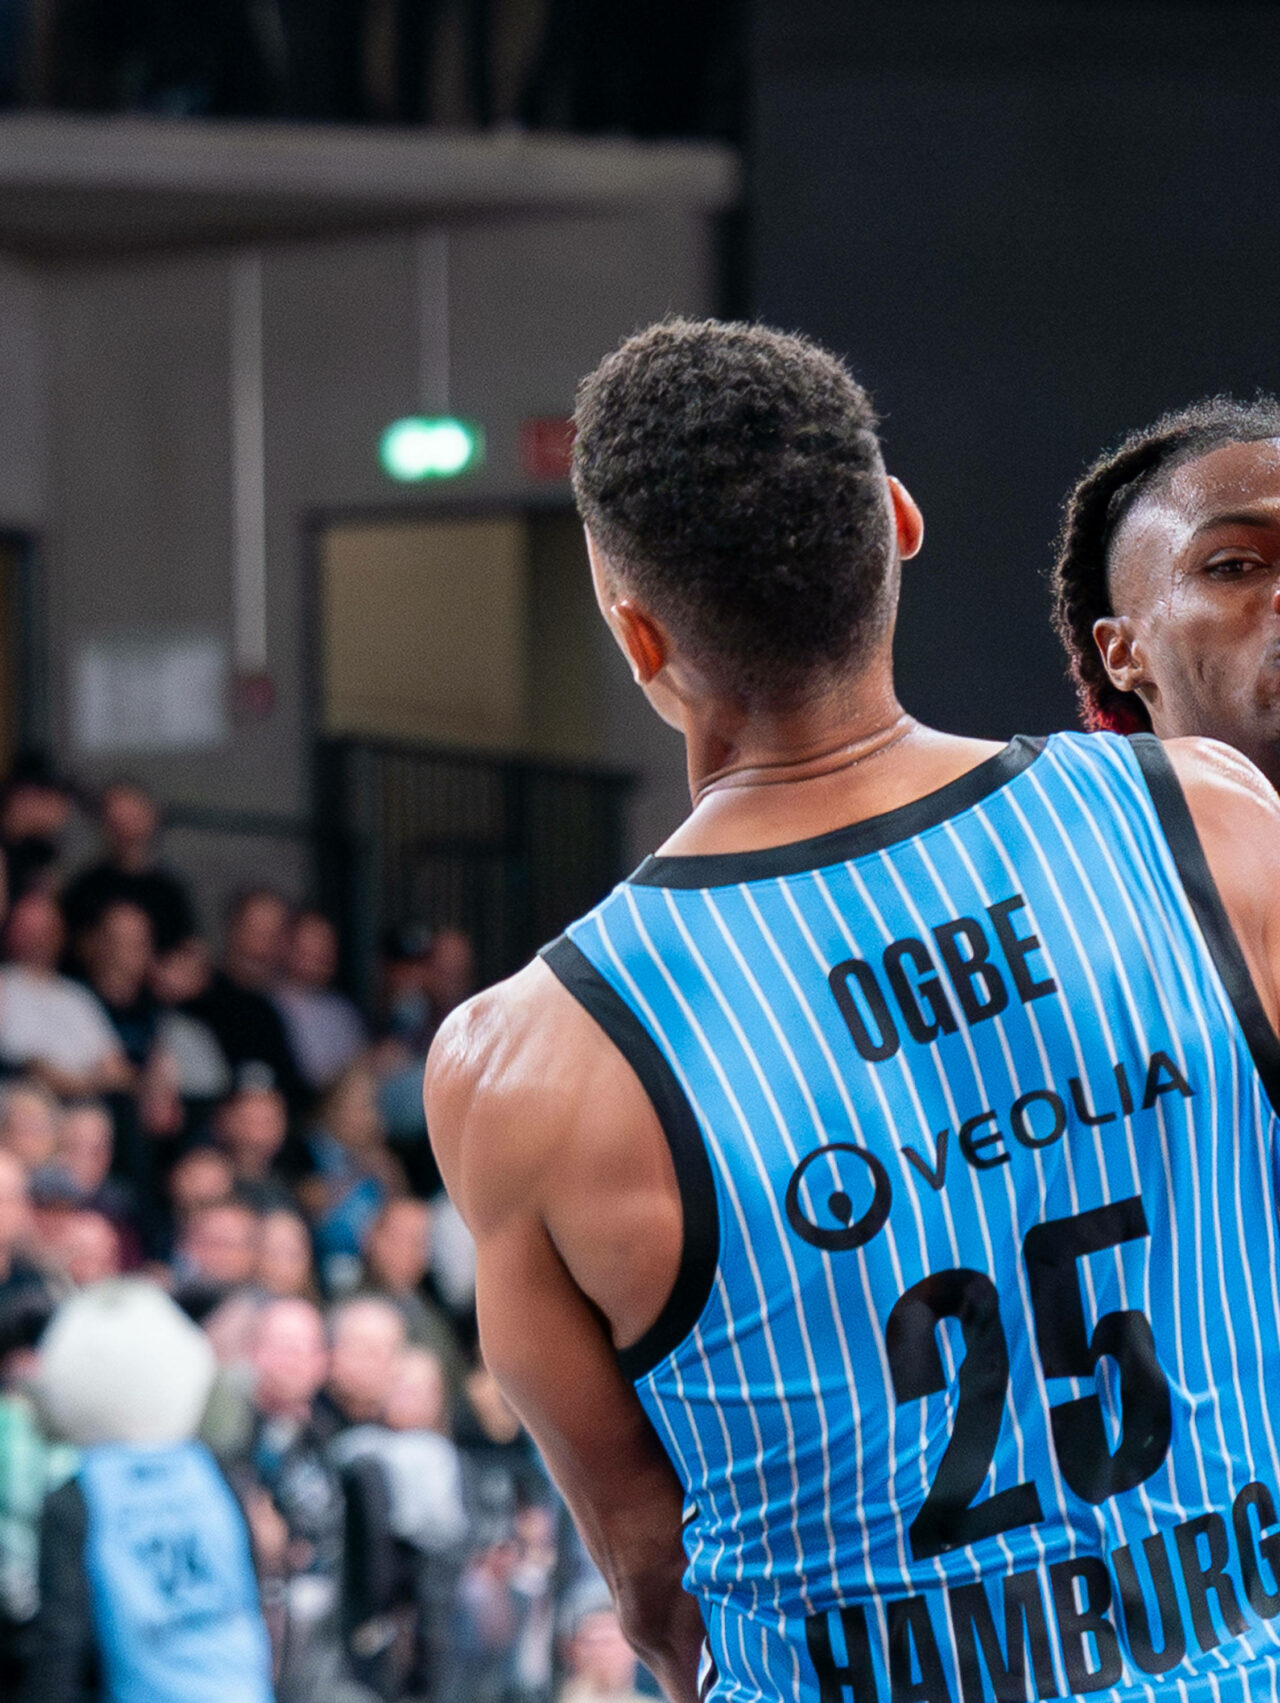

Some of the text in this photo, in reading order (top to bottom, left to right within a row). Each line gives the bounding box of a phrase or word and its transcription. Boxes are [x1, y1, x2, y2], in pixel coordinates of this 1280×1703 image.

[827, 894, 1058, 1063] OGBE
[901, 1050, 1197, 1192] VEOLIA
[885, 1194, 1172, 1563] 25
